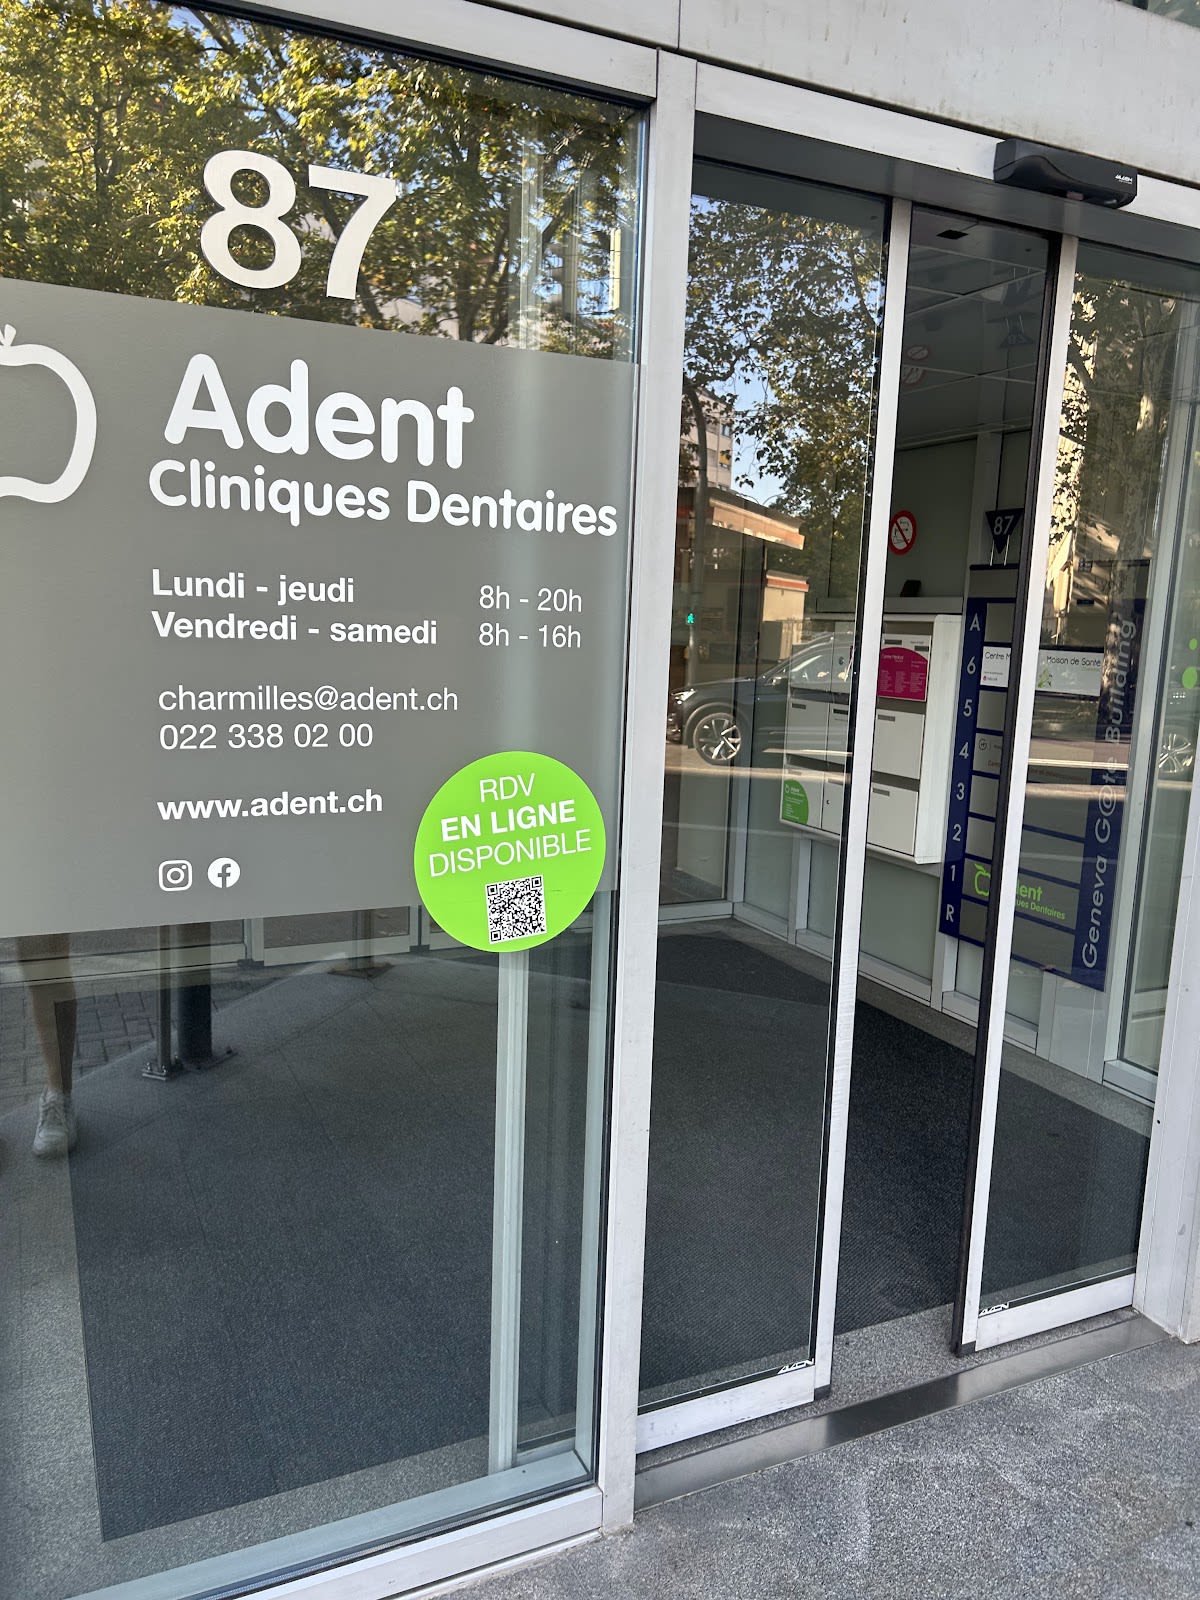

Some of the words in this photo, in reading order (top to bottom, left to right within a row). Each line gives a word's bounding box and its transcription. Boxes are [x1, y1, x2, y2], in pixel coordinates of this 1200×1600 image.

[200, 150, 397, 300] 87
[164, 353, 474, 469] Adent
[149, 458, 390, 526] Cliniques
[407, 480, 618, 536] Dentaires
[993, 515, 1014, 535] 87
[152, 568, 245, 598] Lundi
[277, 574, 355, 605] jeudi
[479, 585, 510, 610] 8h
[537, 588, 582, 613] 20h
[152, 610, 297, 641] Vendredi
[330, 620, 438, 645] samedi
[479, 623, 510, 647] 8h
[541, 625, 582, 648] 16h
[969, 612, 981, 632] A
[966, 656, 976, 675] 6
[1070, 657, 1080, 666] de
[158, 685, 459, 711] charmilles@adent.ch
[963, 699, 973, 717] 5
[159, 724, 217, 750] 022
[228, 723, 284, 748] 338
[294, 723, 329, 748] 02
[339, 723, 374, 747] 00
[959, 742, 969, 760] 4
[479, 773, 536, 802] RDV
[956, 782, 965, 800] 3
[1082, 855, 1108, 969] Geneva
[1105, 620, 1137, 744] Building
[157, 789, 384, 820] www.adent.ch
[440, 815, 481, 842] EN
[490, 799, 577, 834] LIGNE
[952, 823, 961, 842] 2
[428, 828, 592, 877] DISPONIBLE
[950, 865, 956, 882] 1
[946, 903, 955, 922] R
[1030, 902, 1066, 920] Dentaires
